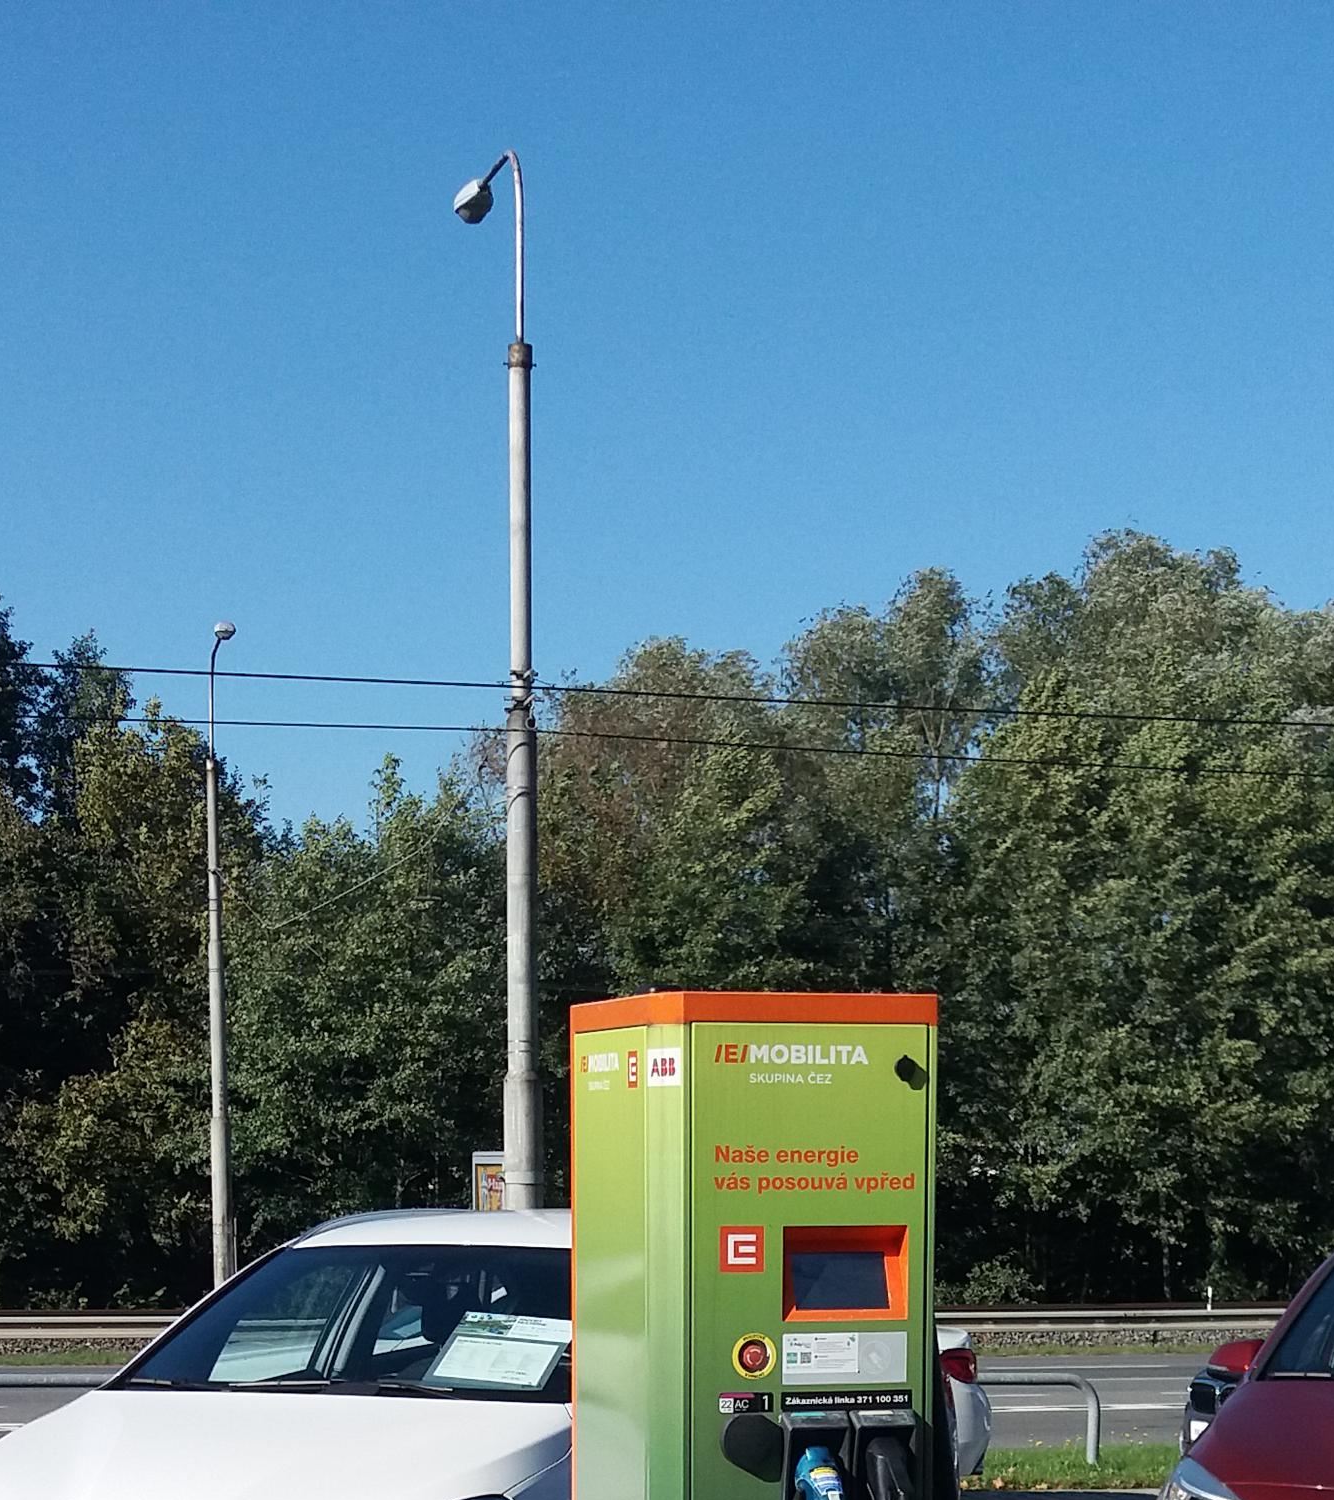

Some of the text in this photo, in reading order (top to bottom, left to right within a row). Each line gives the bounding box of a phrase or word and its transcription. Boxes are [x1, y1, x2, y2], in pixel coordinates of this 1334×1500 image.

[650, 1057, 676, 1077] ABB
[749, 1071, 833, 1085] SKUPINA ČEZ
[714, 1145, 860, 1169] Naše energie
[714, 1172, 916, 1195] vás posouvá vpřed
[720, 1394, 769, 1411] 22 AC 1
[785, 1394, 909, 1406] Zákaznická linka 371 100 351
